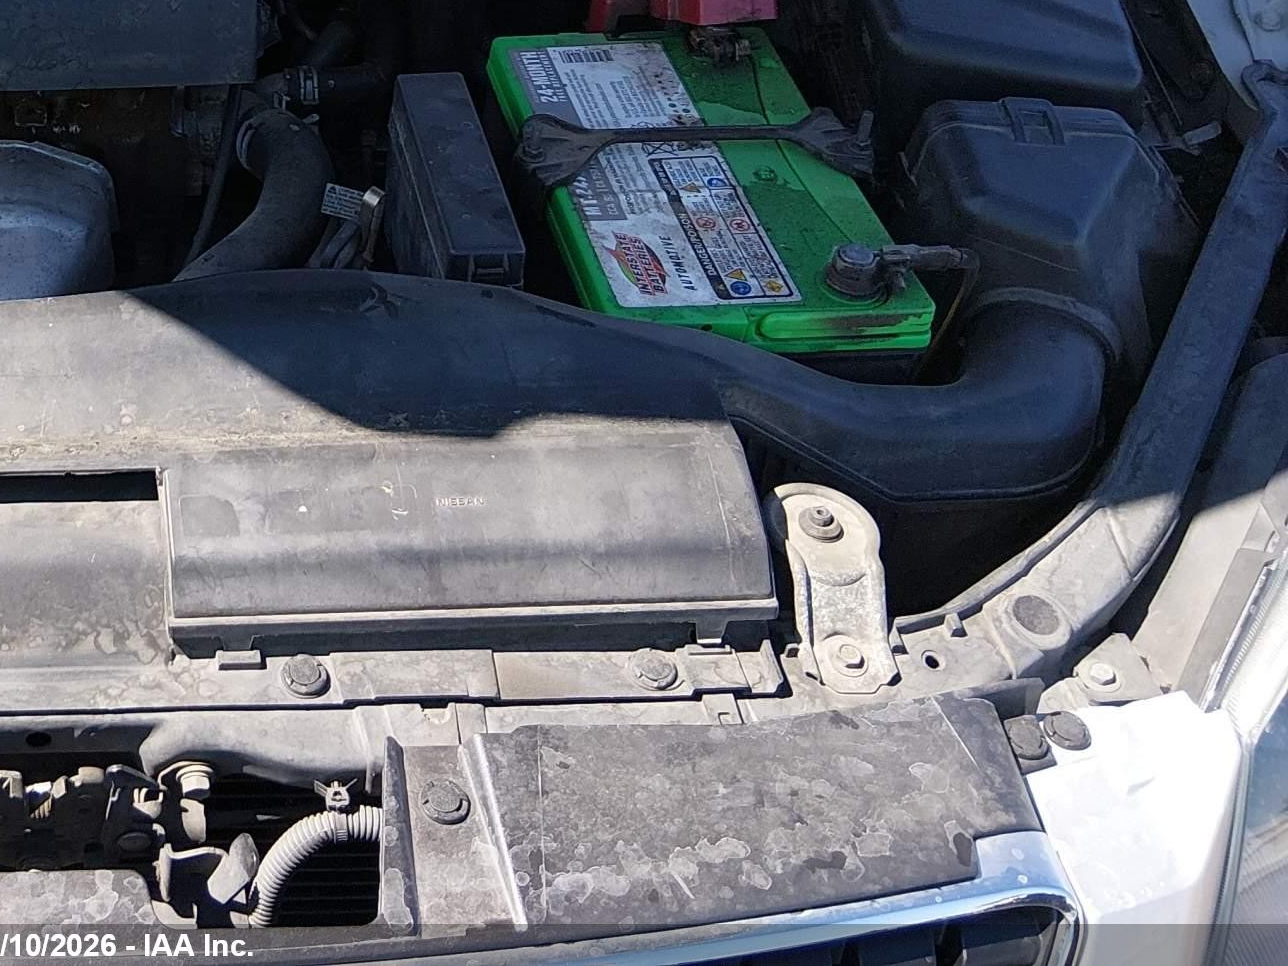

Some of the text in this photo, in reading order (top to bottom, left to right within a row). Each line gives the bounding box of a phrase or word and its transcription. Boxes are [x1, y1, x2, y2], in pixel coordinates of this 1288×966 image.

[519, 51, 560, 103] 24-MONTH
[616, 234, 654, 295] INTERSTATE
[630, 237, 665, 292] BATTERIES
[659, 235, 698, 291] AUTOMOTIVE
[678, 214, 717, 277] DANGER/POISON
[435, 496, 486, 507] NISSAN
